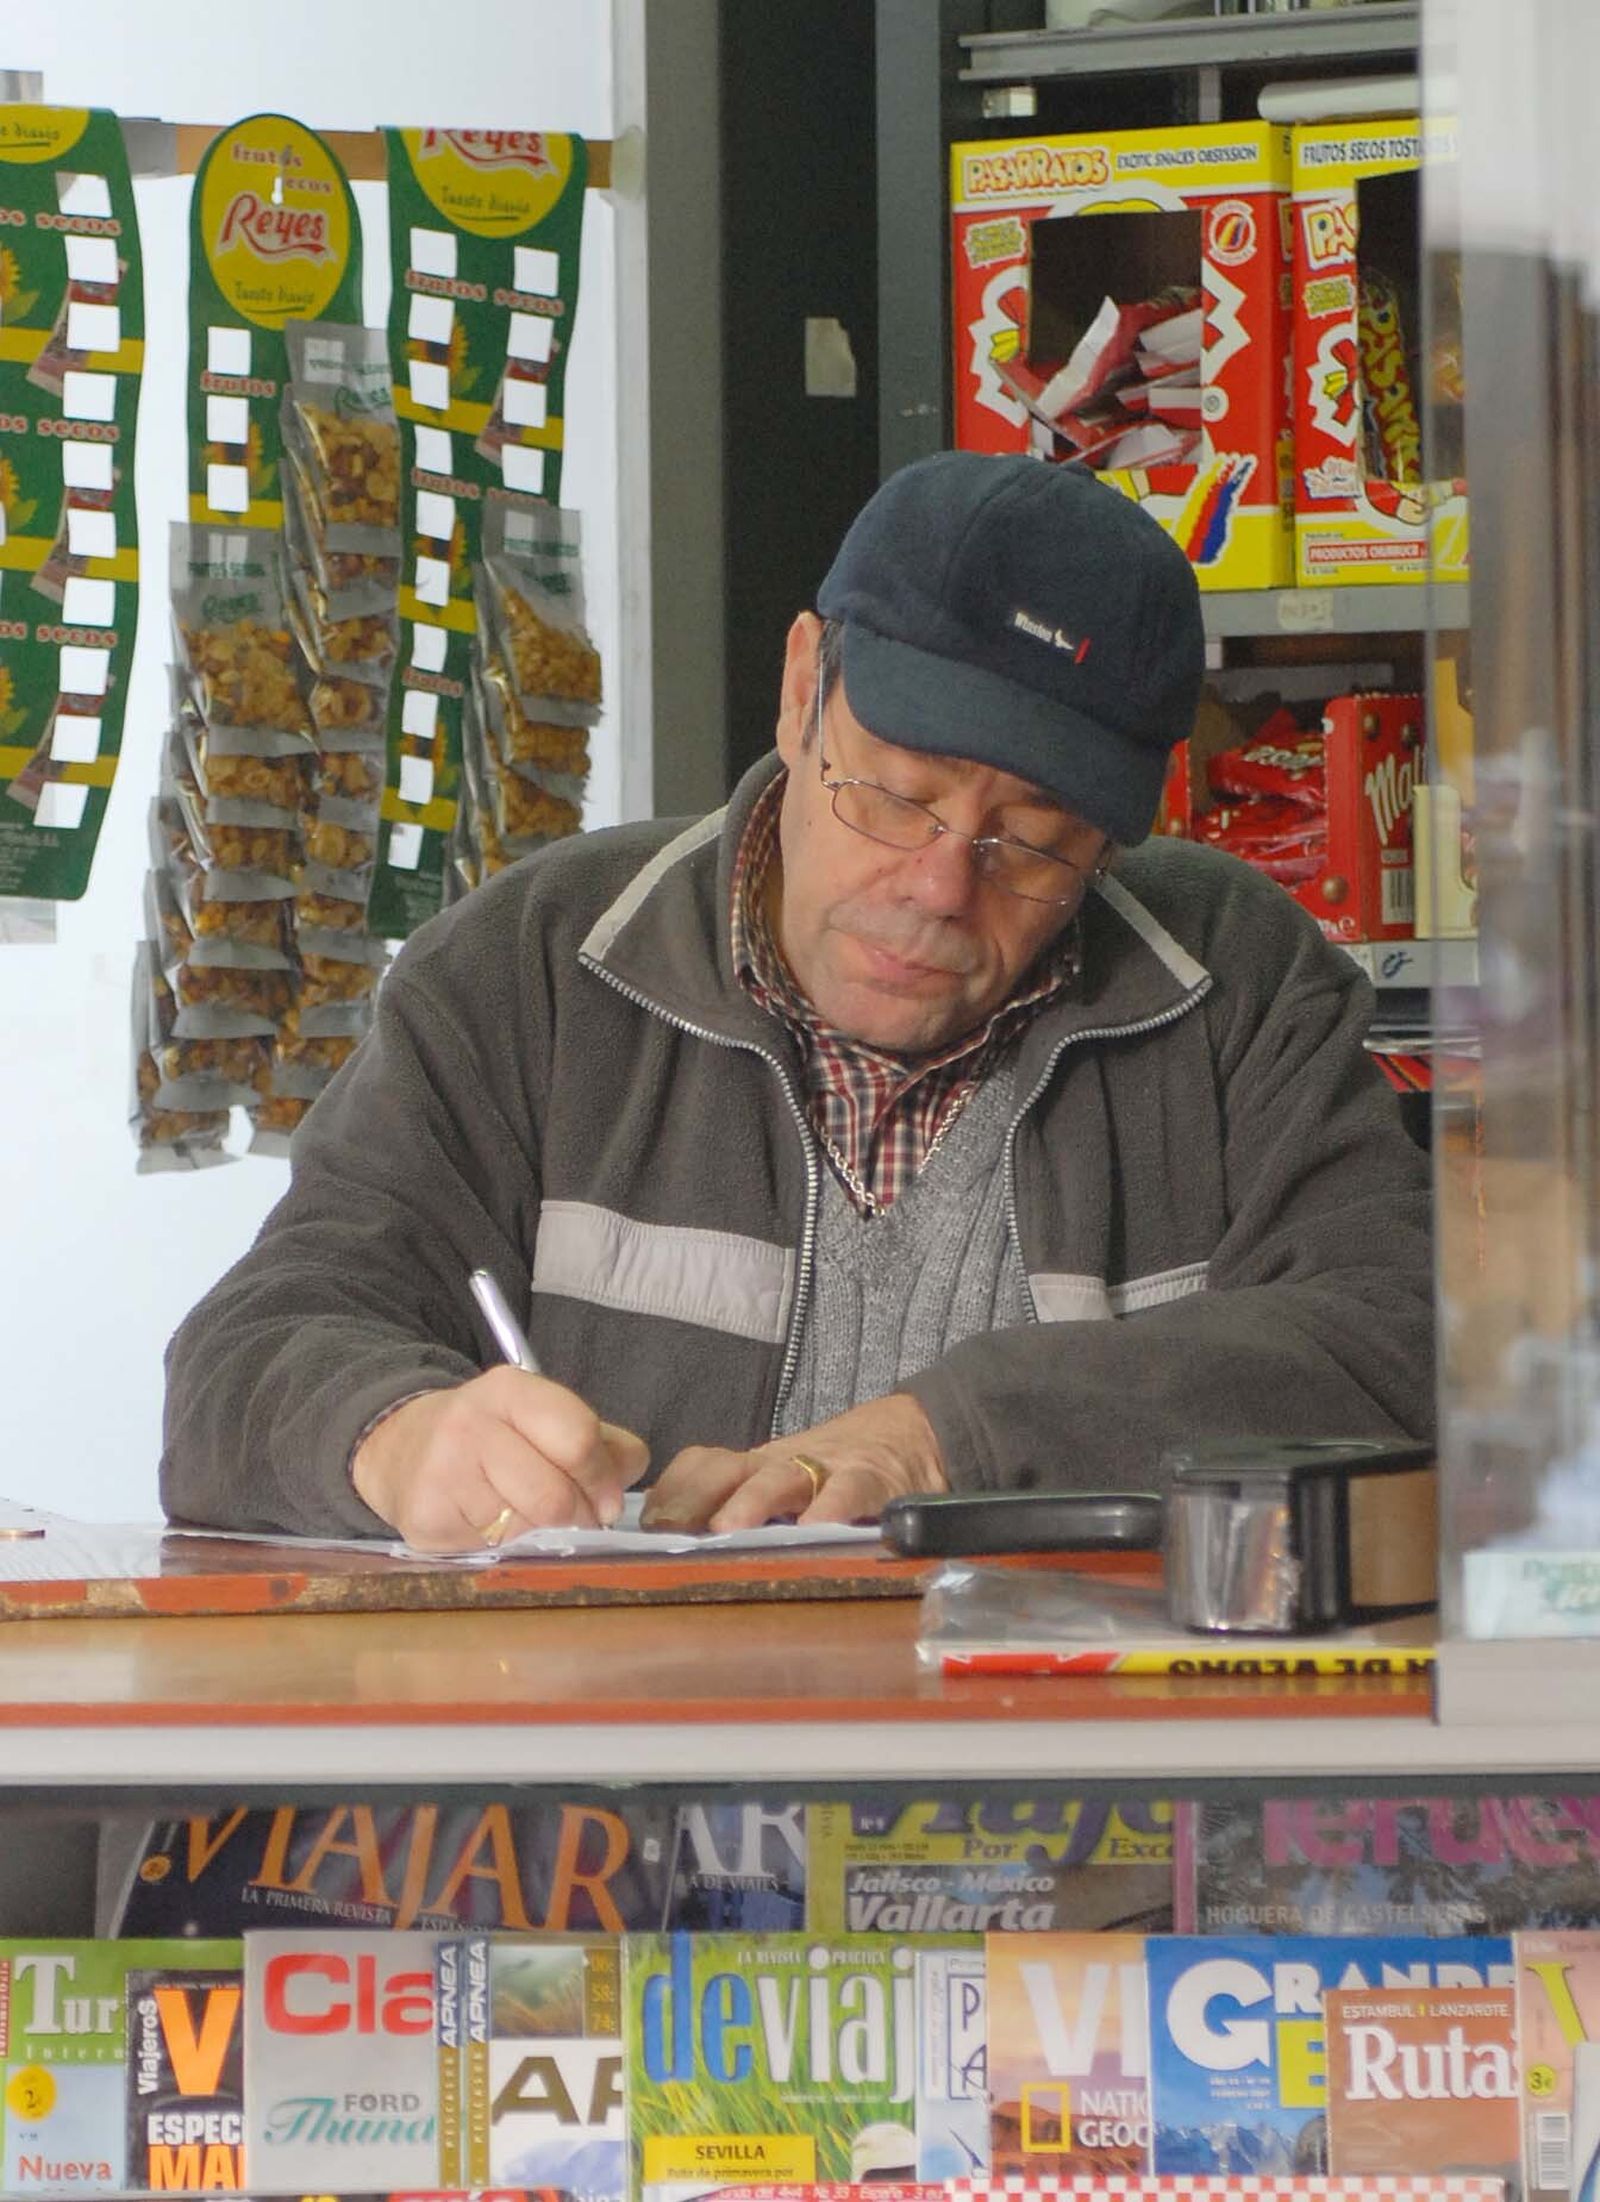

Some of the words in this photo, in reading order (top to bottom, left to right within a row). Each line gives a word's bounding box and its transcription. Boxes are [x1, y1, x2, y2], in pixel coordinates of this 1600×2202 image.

[36, 212, 121, 237] secos
[221, 193, 328, 256] Reyes
[202, 369, 276, 398] frutos
[37, 418, 119, 443] secos
[36, 624, 118, 648] secos
[849, 1872, 937, 1893] Jalisco
[849, 1895, 1056, 1932] Vallarta
[1206, 1904, 1303, 1926] HOGUERA
[15, 1955, 124, 2036] Tur
[263, 1953, 435, 2036] Cla
[439, 1944, 457, 2048] APNEA
[467, 1939, 487, 2044] APNEA
[1342, 2002, 1417, 2019] ESTAMBUL
[1429, 2003, 1511, 2018] LANZAROTE
[344, 2094, 421, 2112] FORD
[695, 2144, 766, 2161] SEVILLA
[18, 2155, 113, 2181] Nueva
